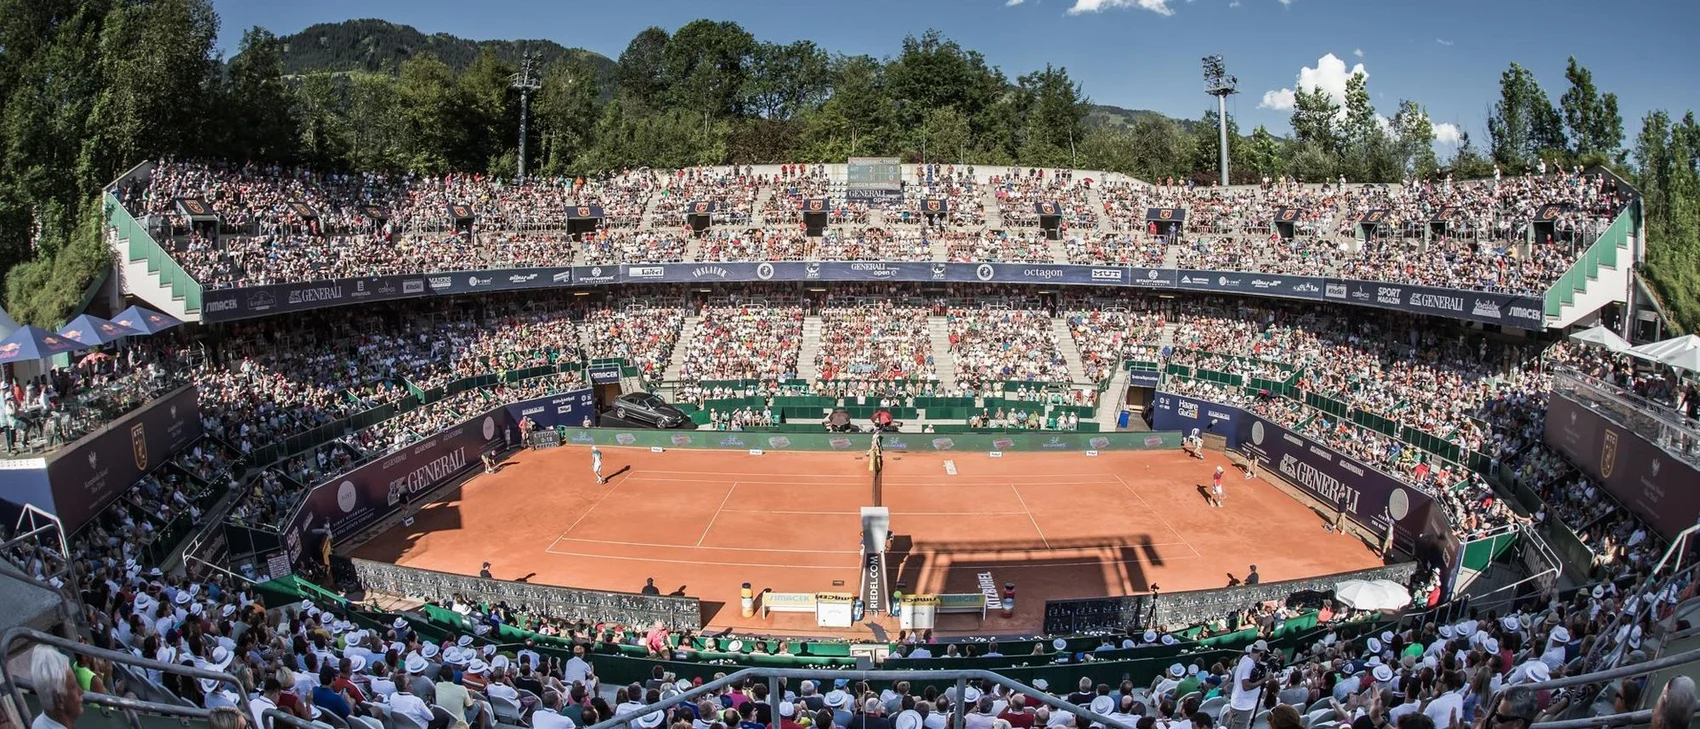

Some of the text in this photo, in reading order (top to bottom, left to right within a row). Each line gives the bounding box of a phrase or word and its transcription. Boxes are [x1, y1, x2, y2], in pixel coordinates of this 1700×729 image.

[848, 190, 885, 198] GENERALI
[1024, 268, 1063, 279] octagon
[301, 286, 343, 302] GENERALI
[1377, 287, 1401, 298] SPORT
[1421, 294, 1464, 311] GENERALI
[1508, 306, 1541, 321] SIMACEK
[534, 430, 558, 438] CITIZEN
[536, 441, 559, 450] CITIZEN
[407, 446, 467, 494] GENERALI
[1297, 461, 1361, 515] GENERALI
[768, 594, 810, 602] SIMACEK
